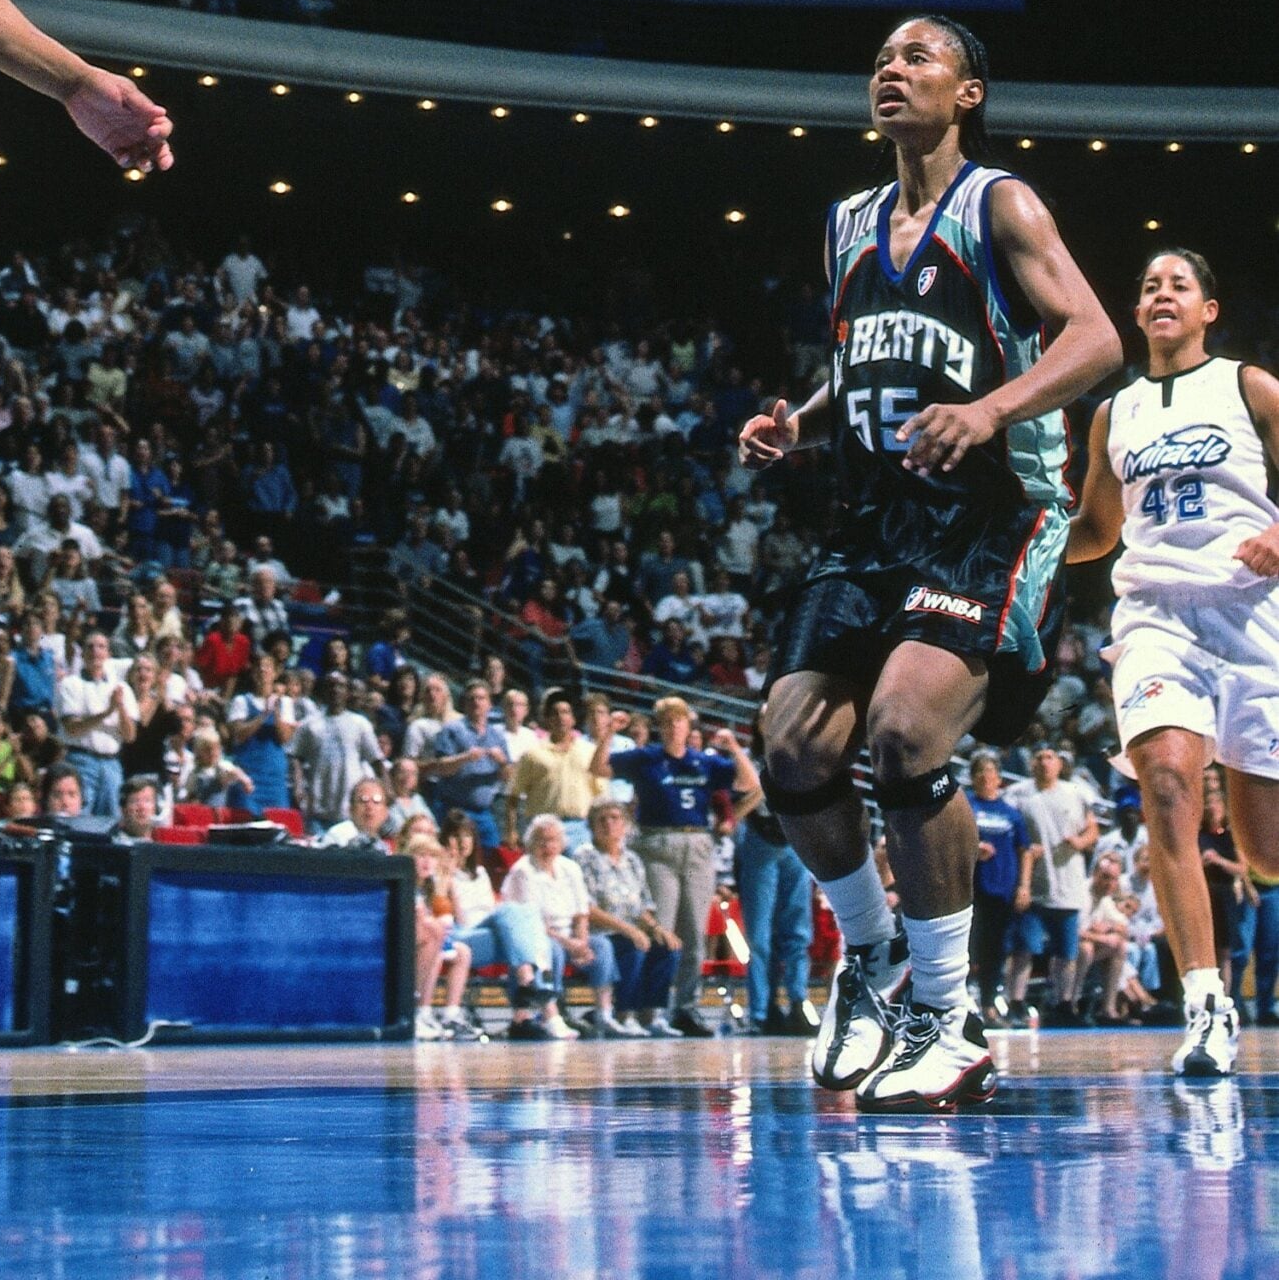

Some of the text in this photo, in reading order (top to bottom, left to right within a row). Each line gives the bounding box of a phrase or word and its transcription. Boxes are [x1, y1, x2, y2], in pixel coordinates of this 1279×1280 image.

[1123, 432, 1233, 485] Miracle
[1141, 474, 1208, 525] 42
[923, 591, 982, 621] WNBA
